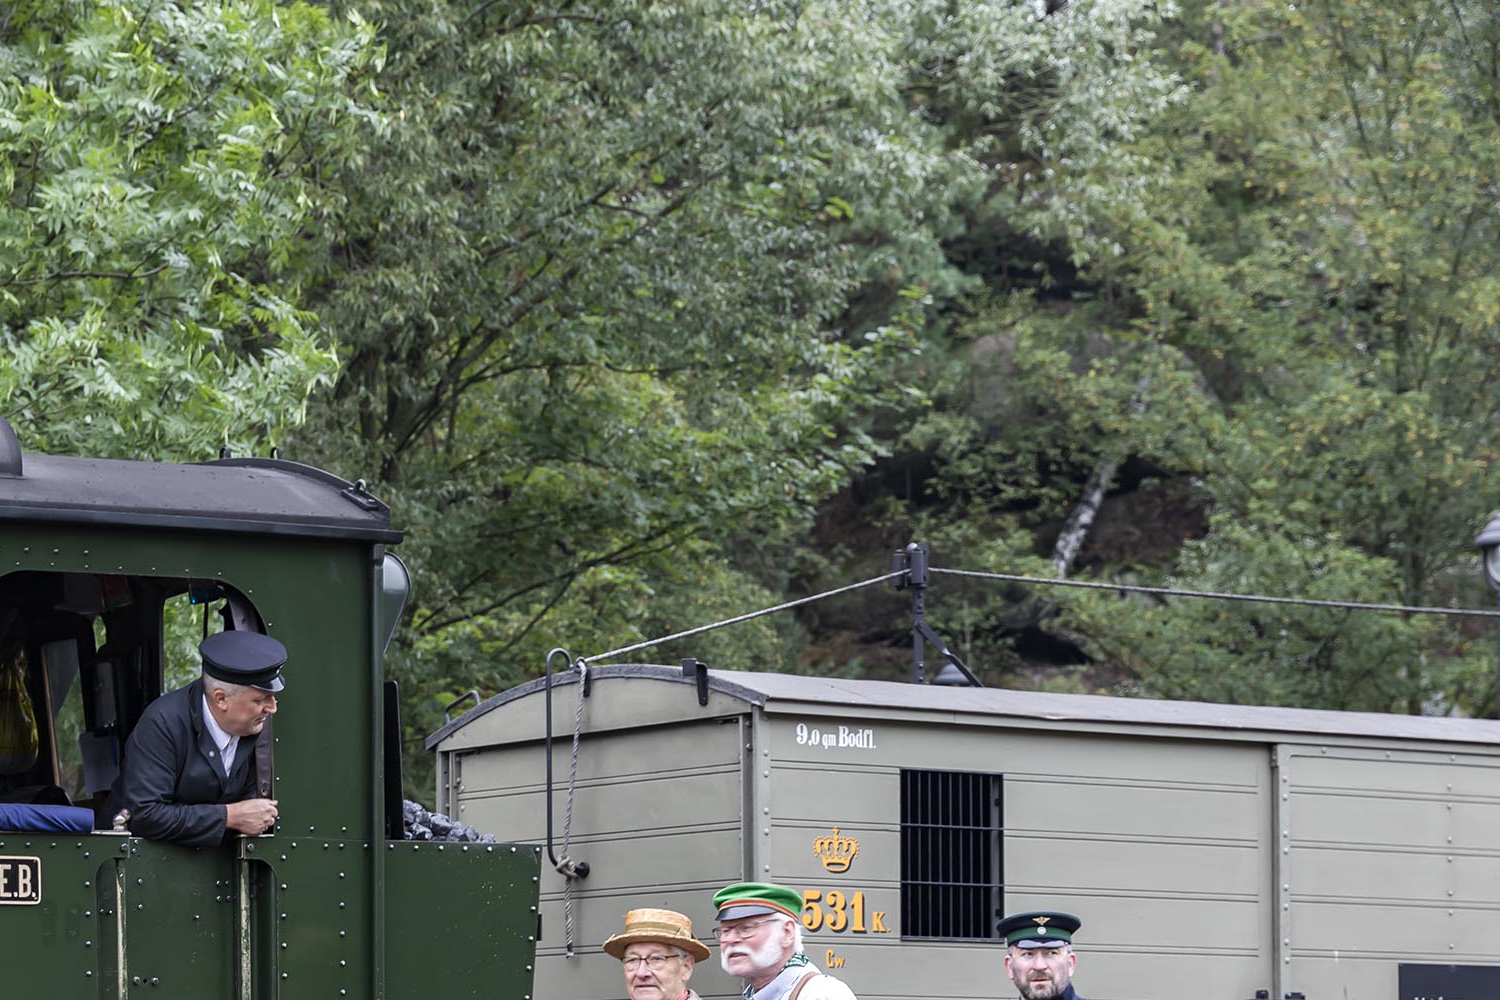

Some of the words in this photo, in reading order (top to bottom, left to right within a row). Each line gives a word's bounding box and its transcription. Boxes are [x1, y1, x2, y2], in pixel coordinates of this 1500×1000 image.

[796, 723, 820, 746] 9,0
[822, 733, 837, 749] qm
[802, 890, 867, 934] 531
